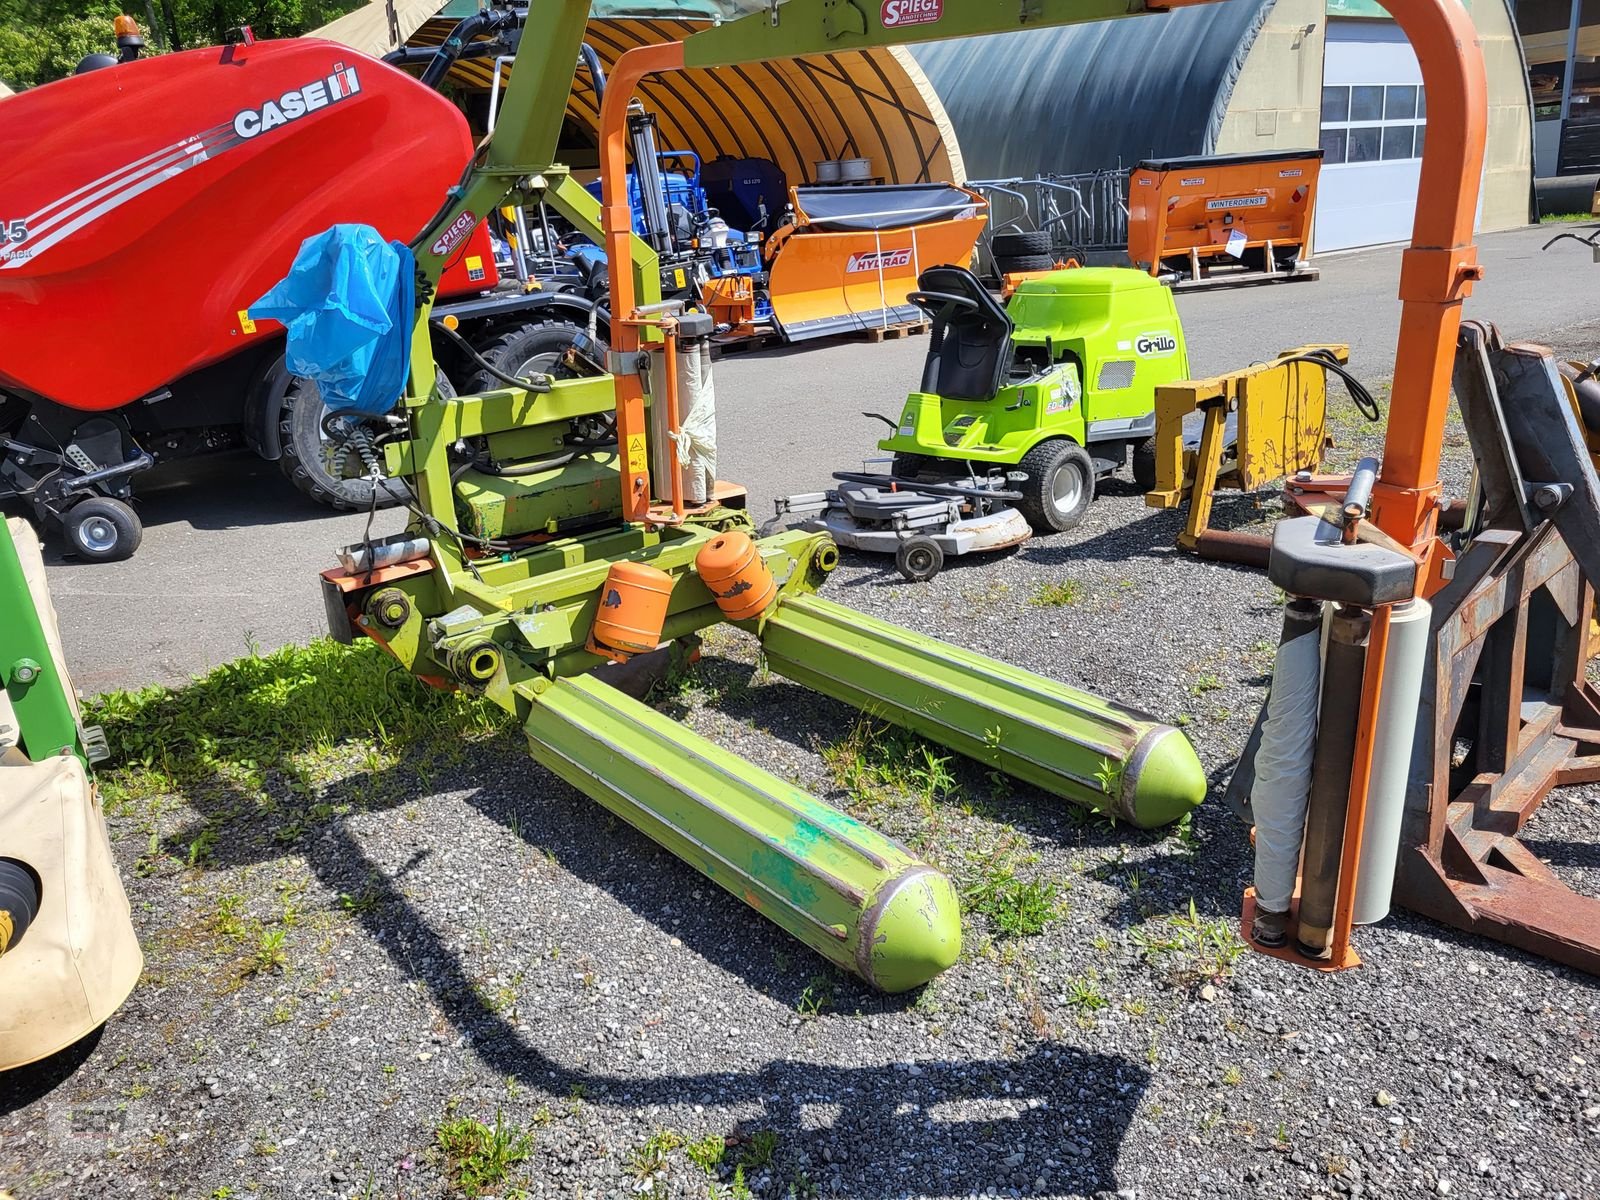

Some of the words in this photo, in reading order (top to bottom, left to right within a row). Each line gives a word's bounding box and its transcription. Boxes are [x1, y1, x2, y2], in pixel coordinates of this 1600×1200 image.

[884, 0, 938, 24] SPIEGL
[234, 80, 328, 138] CASE
[1210, 197, 1264, 208] WINTERDIENST
[433, 213, 472, 255] SPIEGL
[4, 249, 33, 261] PACK
[1137, 336, 1176, 353] Grillo
